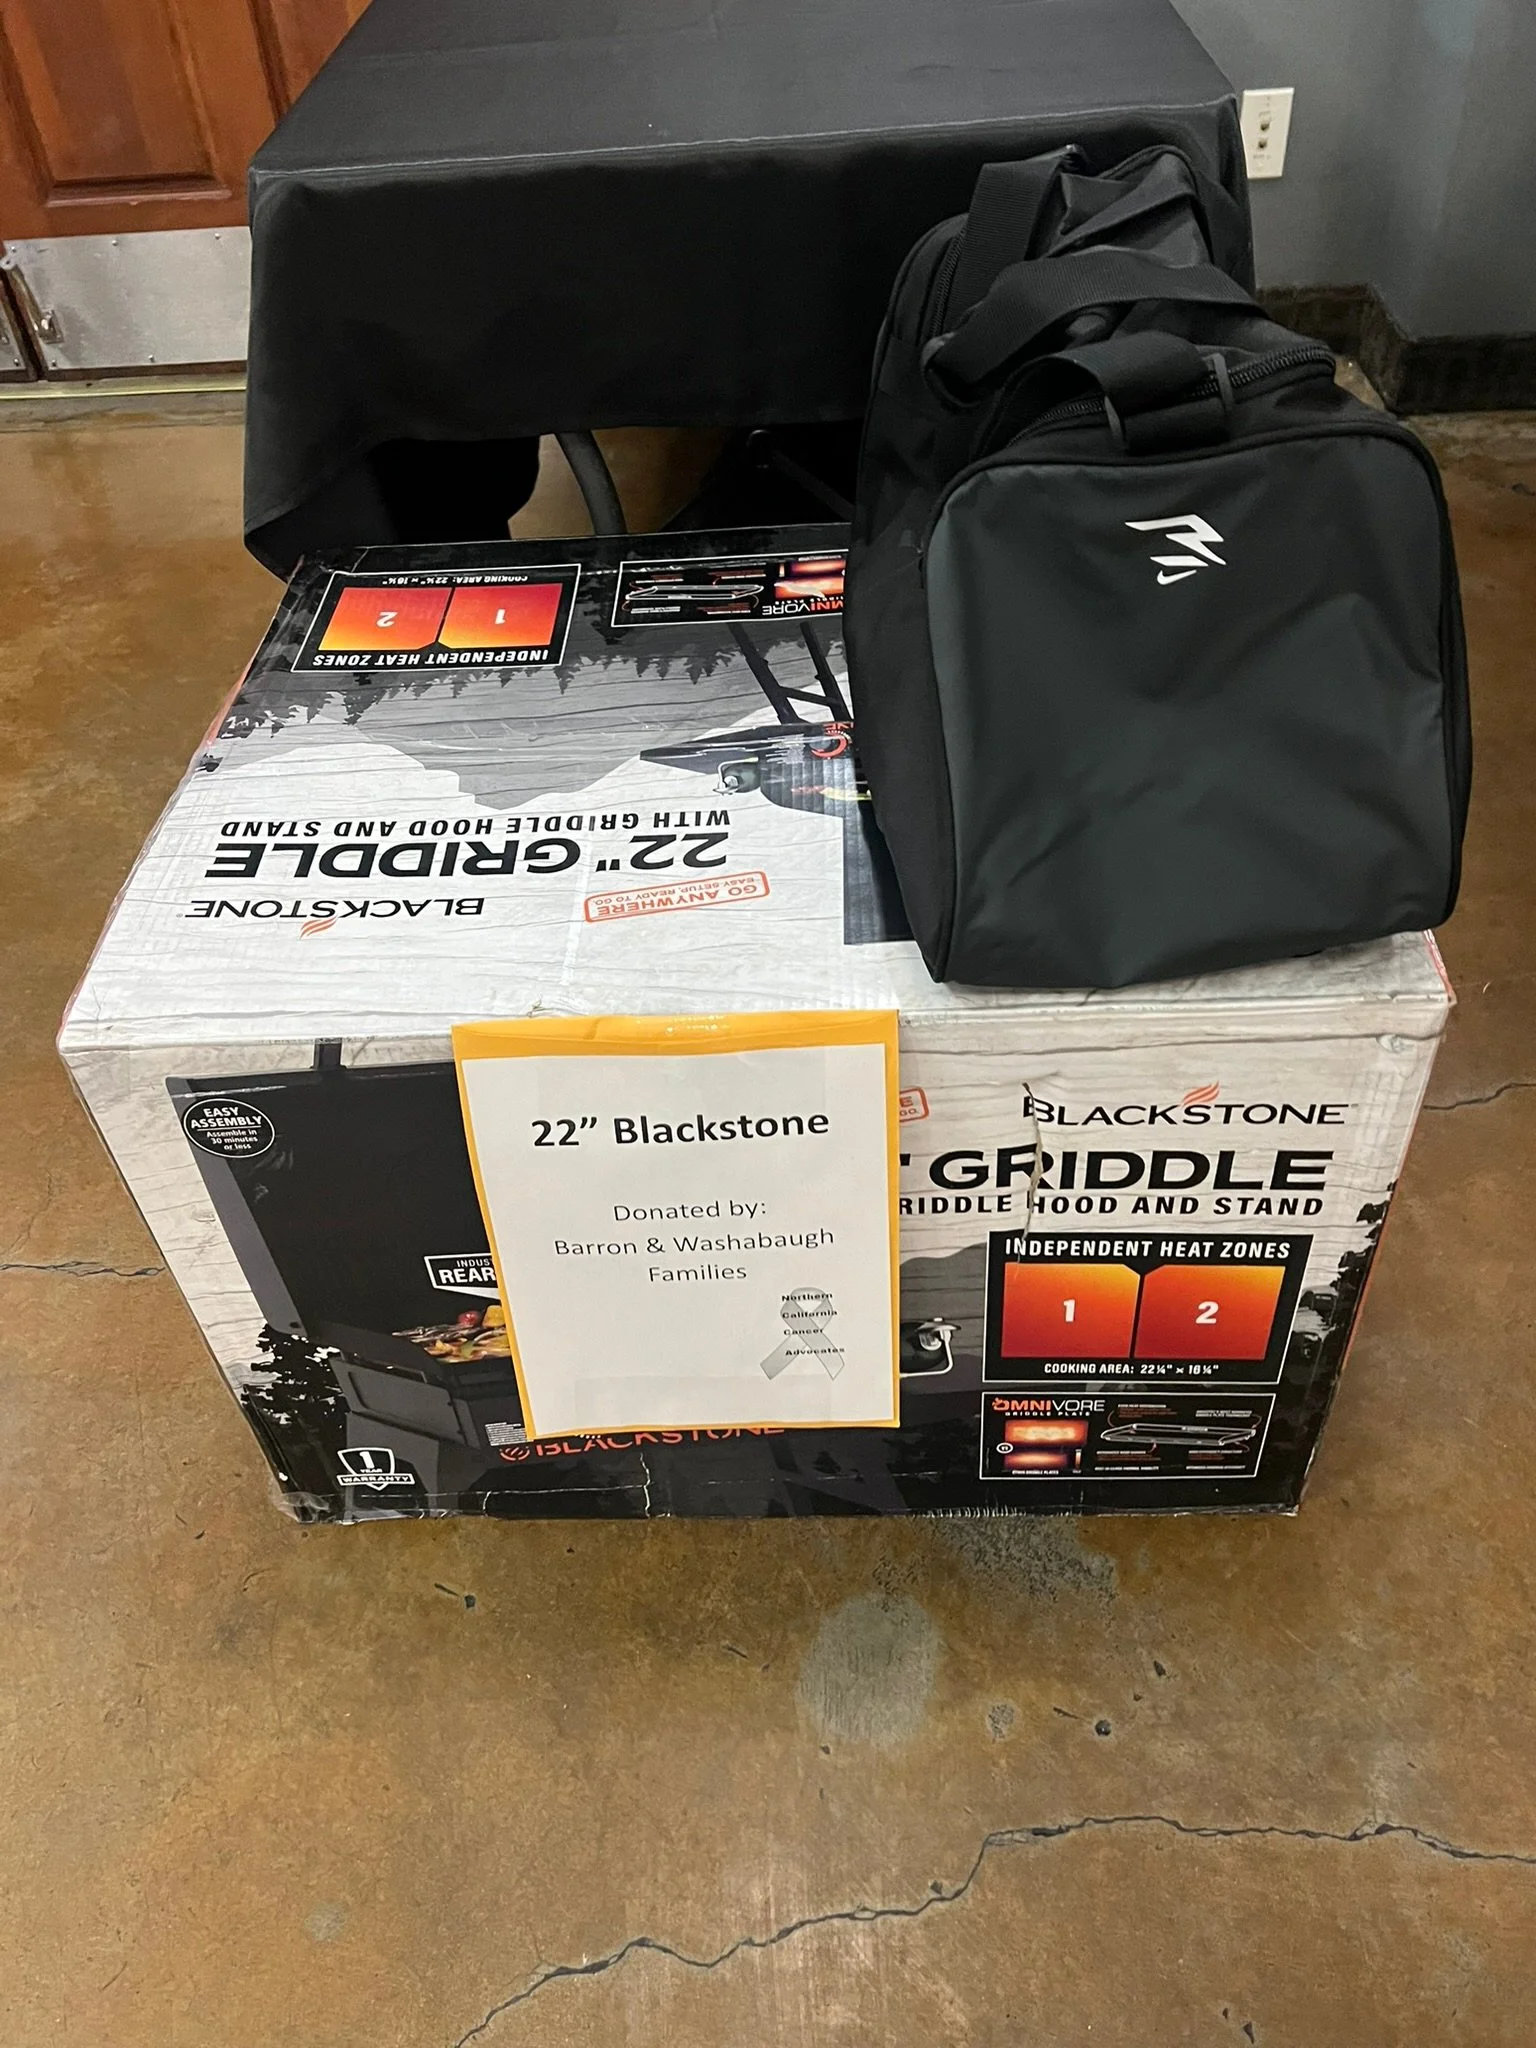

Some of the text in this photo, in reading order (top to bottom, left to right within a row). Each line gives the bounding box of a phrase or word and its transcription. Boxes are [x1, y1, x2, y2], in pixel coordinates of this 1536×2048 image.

[762, 600, 844, 615] MNIVORE
[376, 611, 398, 627] 2
[494, 609, 507, 624] 1
[313, 650, 548, 666] INDEPENDENT HEAT ZONES
[221, 810, 730, 837] WITH GRIDDLE HOOD AND STAND
[205, 837, 581, 878] GRIDDLE
[722, 877, 755, 888] EASY
[596, 884, 757, 917] GO ANYWHERE
[615, 895, 631, 903] TO
[634, 888, 676, 900] READY
[185, 898, 485, 918] BLACKSTONE
[203, 1106, 239, 1118] EASY
[1023, 1096, 1349, 1126] BLACKSTONE
[191, 1115, 262, 1129] ASSEMBLY
[613, 1113, 829, 1145] Blackstone
[207, 1130, 246, 1138] Assemble
[224, 1135, 258, 1143] minutes
[929, 1143, 1335, 1191] GRIDDLE
[614, 1200, 767, 1222] Donated by:
[900, 1191, 1324, 1216] RIDDLE HOOD AND STAND
[555, 1228, 834, 1256] Barron & Washabaugh
[1005, 1238, 1291, 1259] INDEPENDENT HEAT ZONES
[456, 1258, 491, 1268] INDUS
[649, 1264, 747, 1282] Families
[781, 1292, 833, 1302] Northern
[782, 1310, 838, 1319] California
[1063, 1299, 1076, 1322] 1
[1196, 1301, 1219, 1324] 2
[785, 1347, 845, 1356] Advocates
[1044, 1363, 1096, 1374] COOKING
[1099, 1363, 1134, 1374] AREA:
[991, 1397, 1105, 1412] OMNIVORE
[359, 1451, 375, 1469] 1
[342, 1475, 409, 1483] WARRANTY
